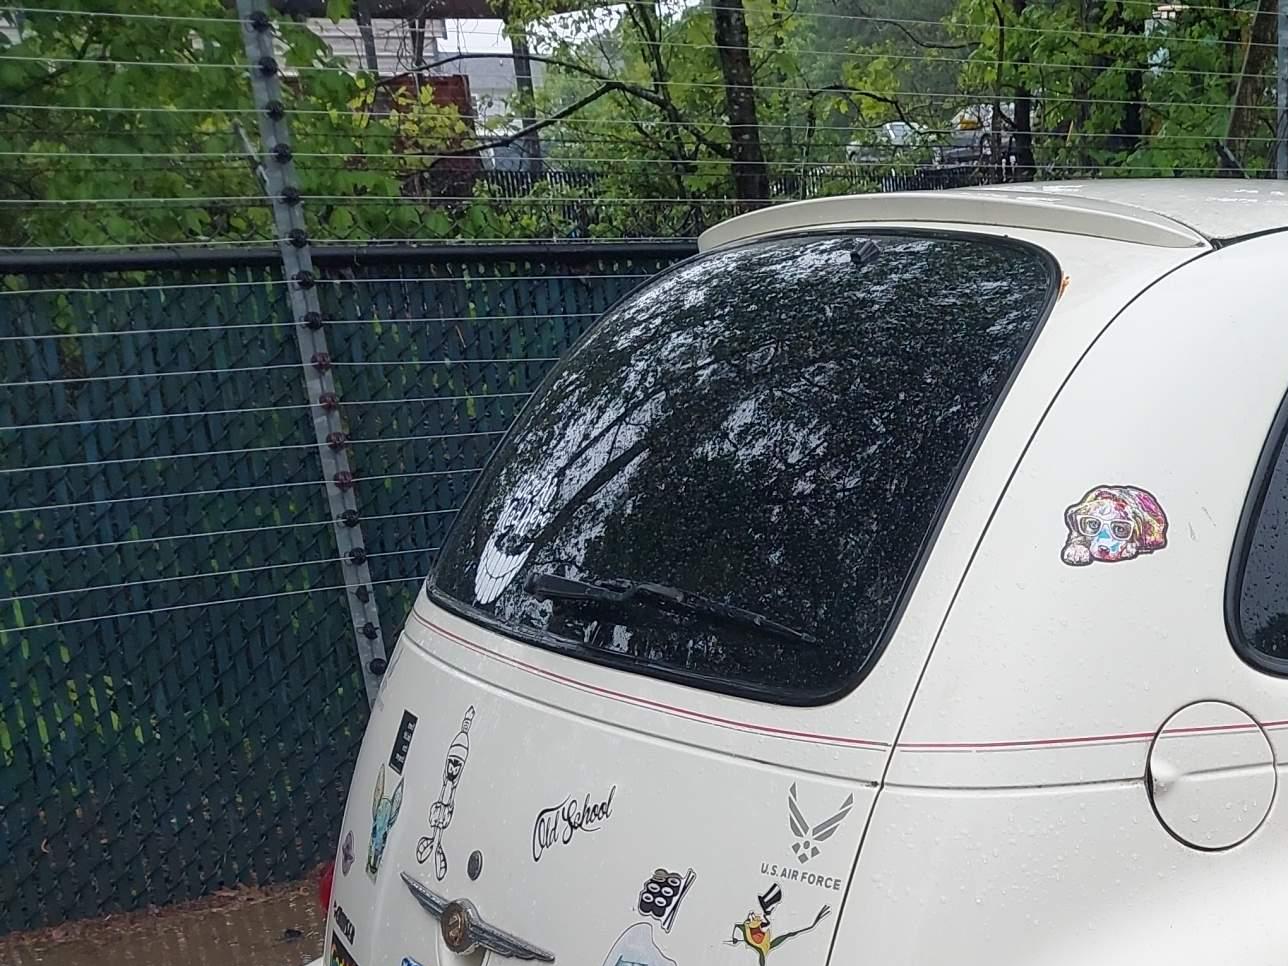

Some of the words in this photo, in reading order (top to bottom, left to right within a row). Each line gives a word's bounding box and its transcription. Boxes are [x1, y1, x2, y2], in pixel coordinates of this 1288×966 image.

[533, 793, 571, 862] Old
[562, 785, 616, 844] School
[761, 863, 779, 877] U.S.
[781, 867, 799, 881] AIR
[801, 872, 842, 890] FORCE
